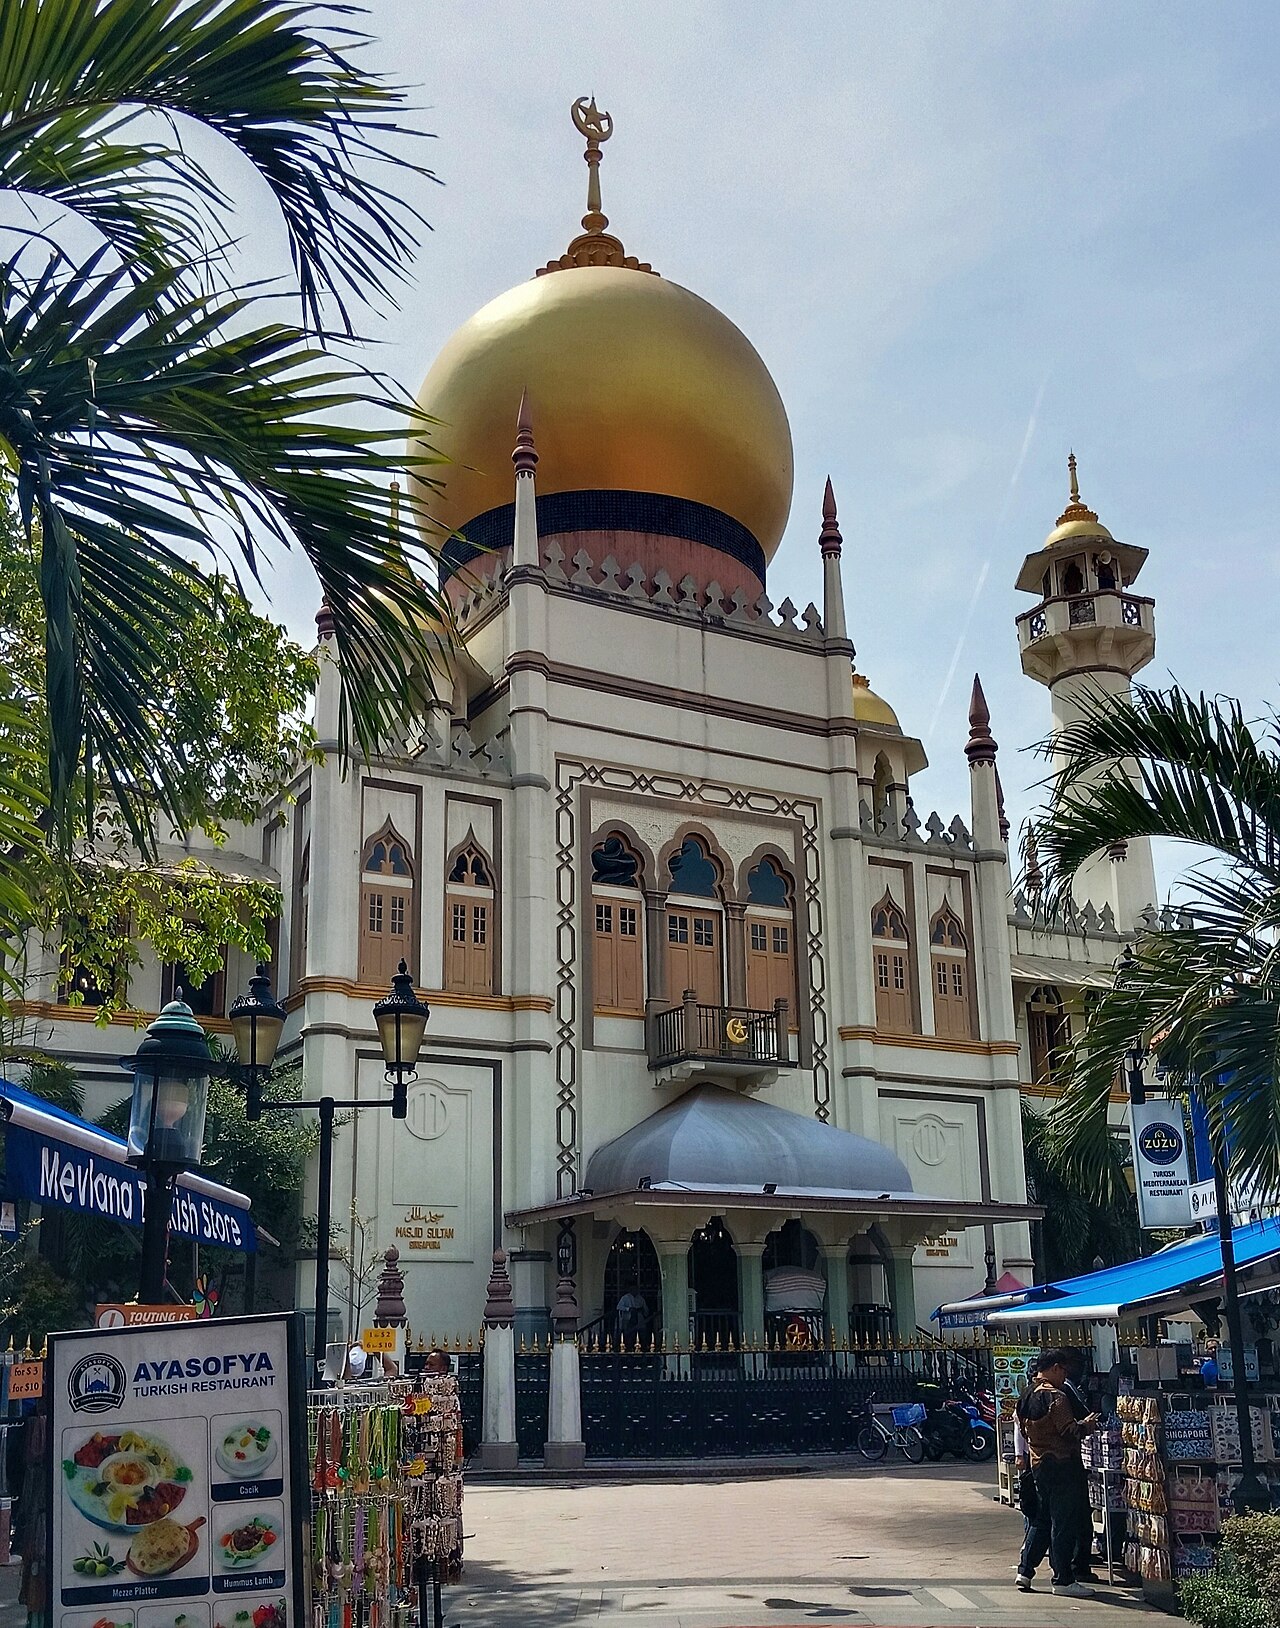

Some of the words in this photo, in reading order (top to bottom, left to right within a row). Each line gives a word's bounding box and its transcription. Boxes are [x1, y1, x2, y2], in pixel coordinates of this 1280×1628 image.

[1144, 1138, 1177, 1149] ZUZU
[40, 1146, 133, 1220] Mevlana
[1142, 1179, 1188, 1188] MEDITERRANEAN
[1149, 1188, 1184, 1197] RESTAURANT
[395, 1226, 424, 1239] MASJID
[426, 1227, 455, 1239] SULTAN
[129, 1311, 176, 1323] TOUTING
[14, 1366, 25, 1377] for
[33, 1366, 39, 1376] 3
[132, 1352, 274, 1383] AYASOFYA
[12, 1383, 24, 1393] for
[24, 1382, 40, 1393] $10
[133, 1383, 188, 1398] TURKISH
[191, 1375, 276, 1393] RESTAURANT
[1165, 1429, 1209, 1439] SINGAPORE
[223, 1577, 253, 1588] Hummus
[254, 1576, 274, 1586] Lamb
[112, 1588, 133, 1598] Mezze
[134, 1586, 158, 1596] Platter
